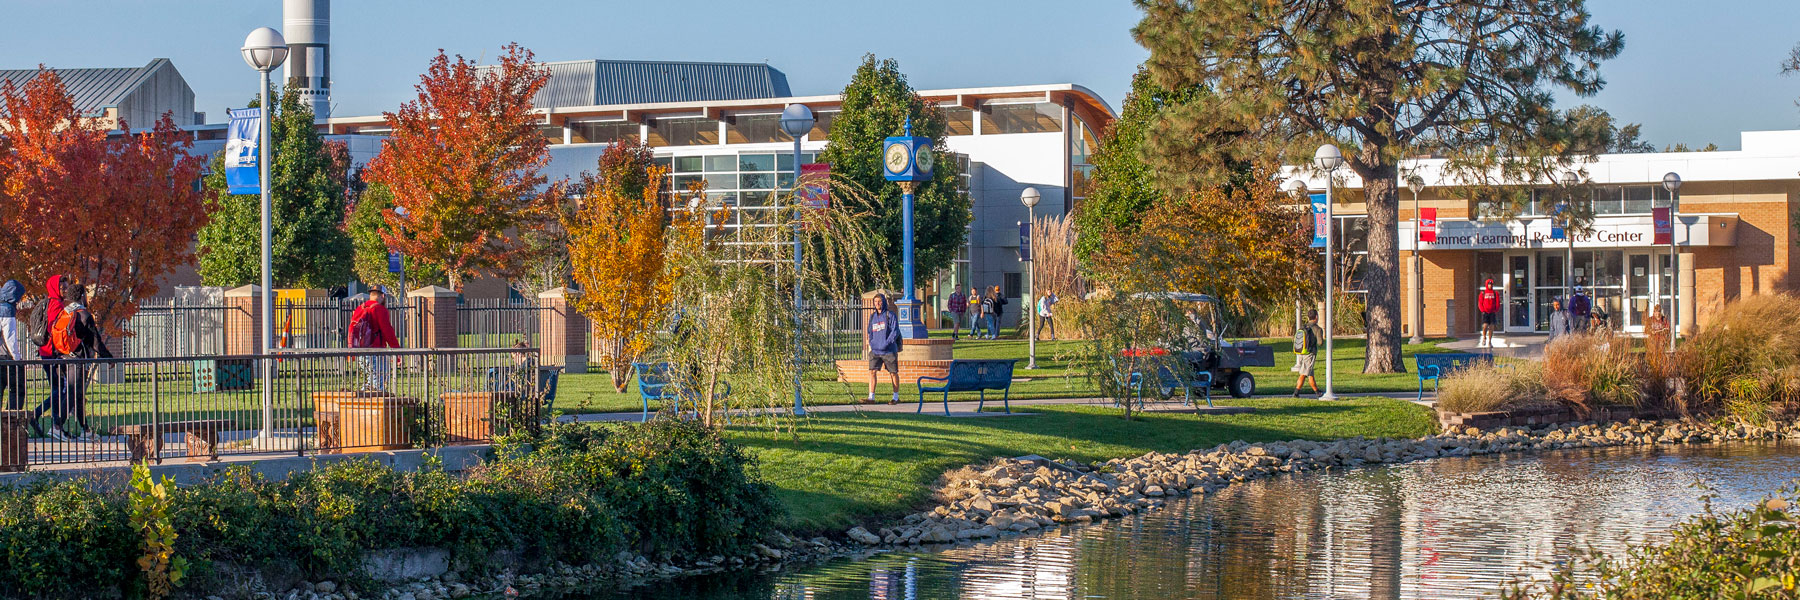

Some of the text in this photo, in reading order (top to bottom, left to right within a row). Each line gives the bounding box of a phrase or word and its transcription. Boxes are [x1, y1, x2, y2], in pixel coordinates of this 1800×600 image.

[1427, 235, 1472, 245] mmer
[1476, 232, 1526, 246] Learning
[1533, 231, 1592, 244] Resrce
[1597, 230, 1643, 243] Center
